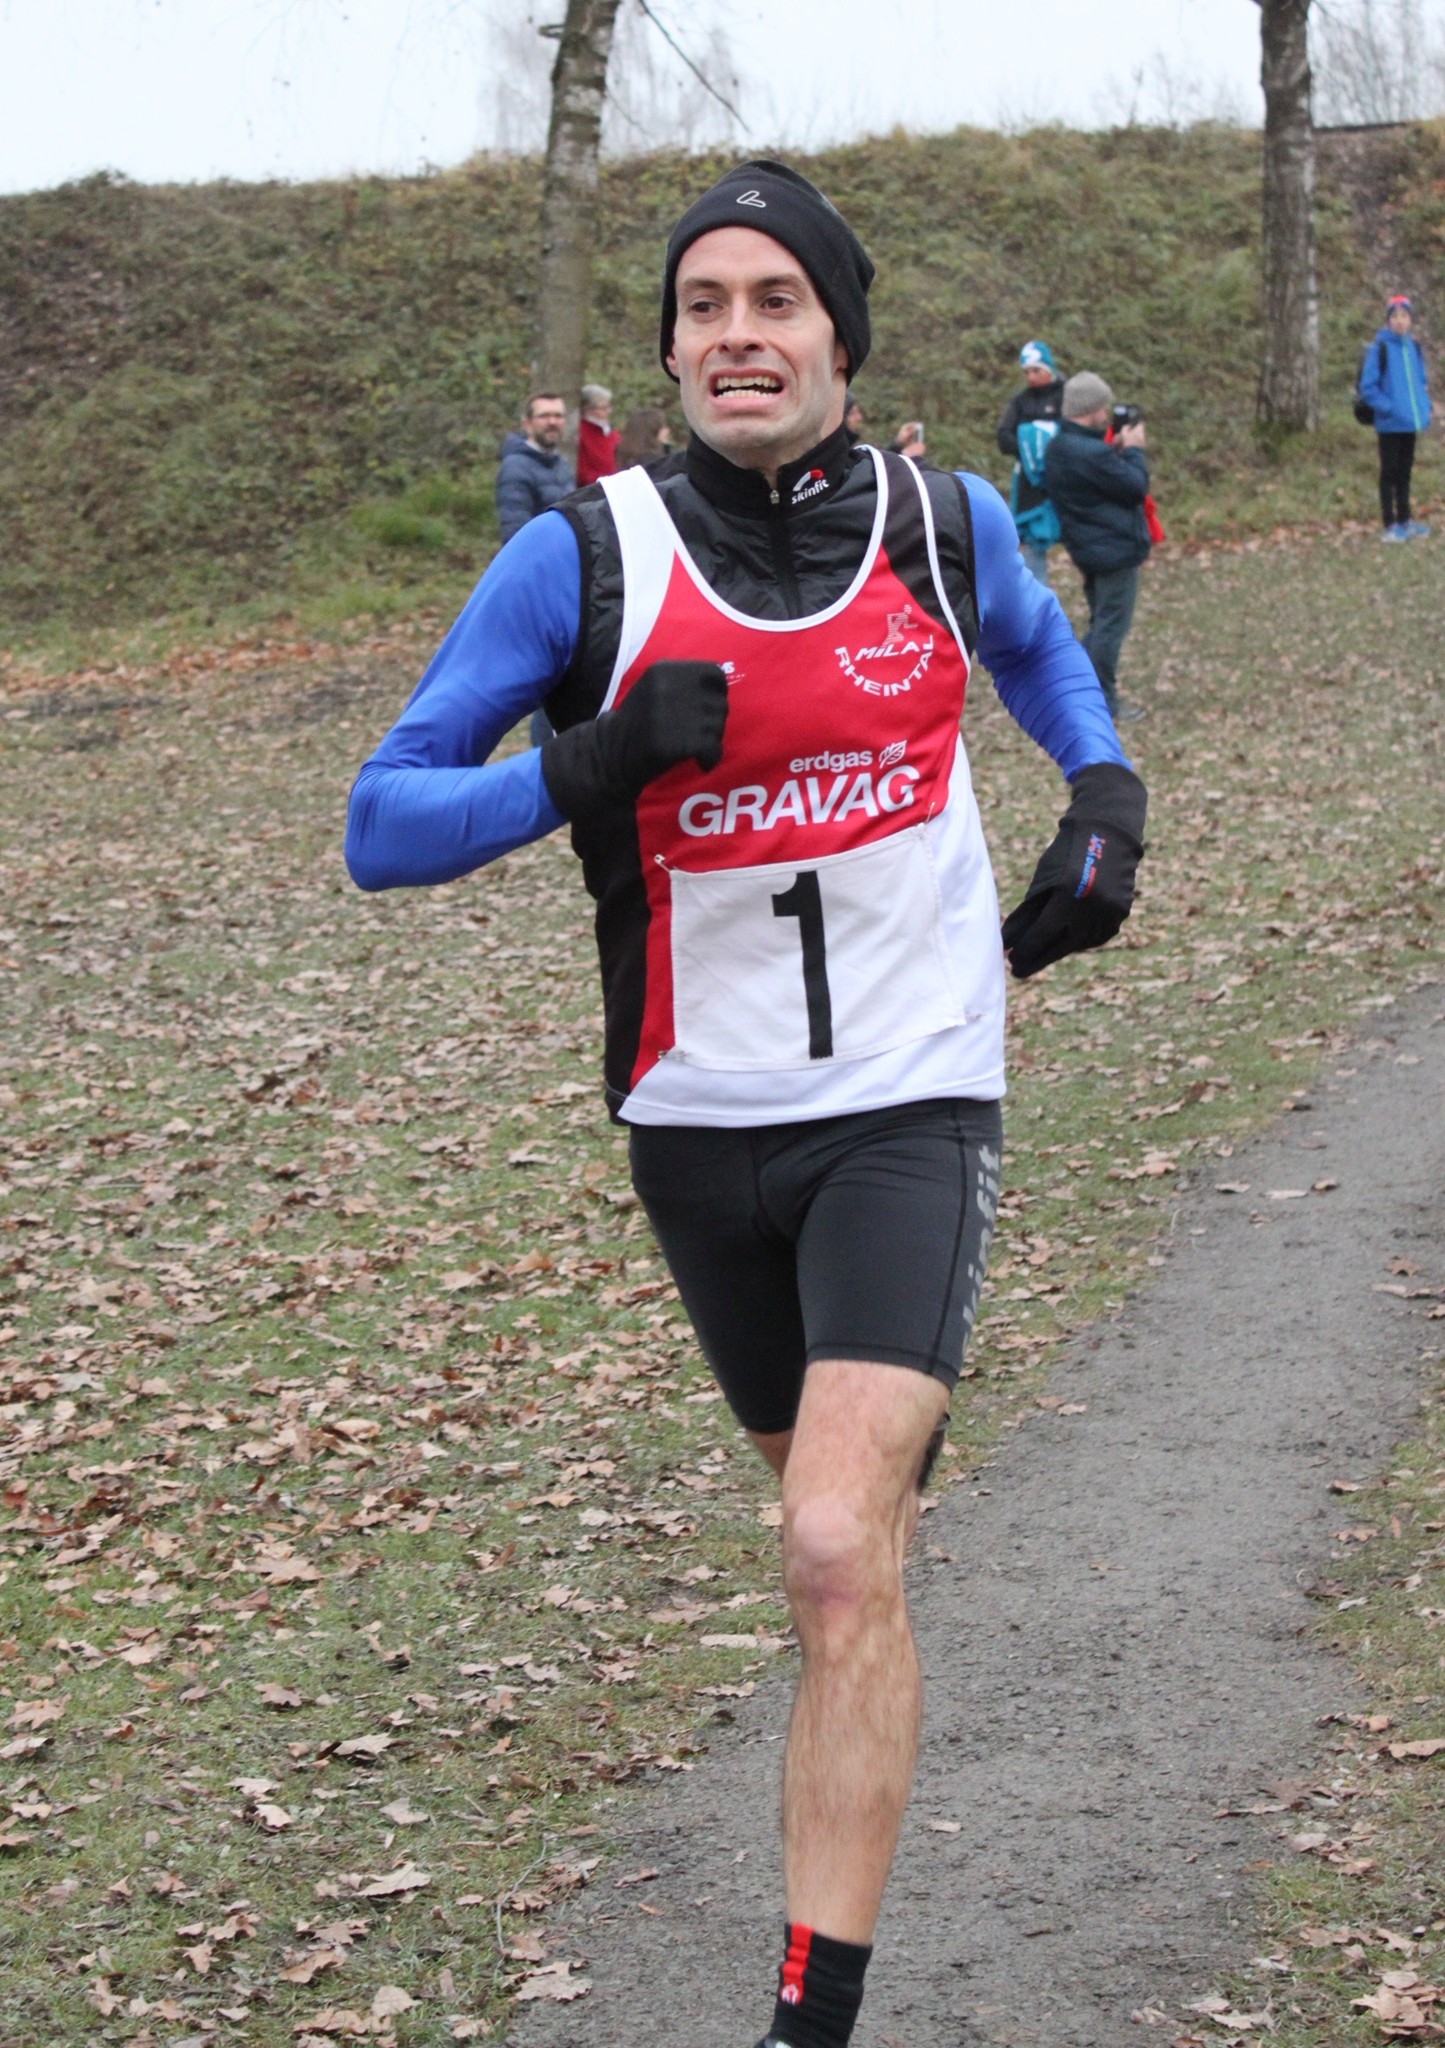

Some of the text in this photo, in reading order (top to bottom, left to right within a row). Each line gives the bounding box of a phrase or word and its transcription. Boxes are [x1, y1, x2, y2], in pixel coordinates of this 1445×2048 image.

[791, 479, 830, 505] skinfit
[834, 634, 934, 697] RHEINTAL
[854, 641, 920, 661] MILA
[789, 750, 873, 773] erdgas
[678, 765, 920, 837] GRAVAG
[771, 869, 834, 1060] 1
